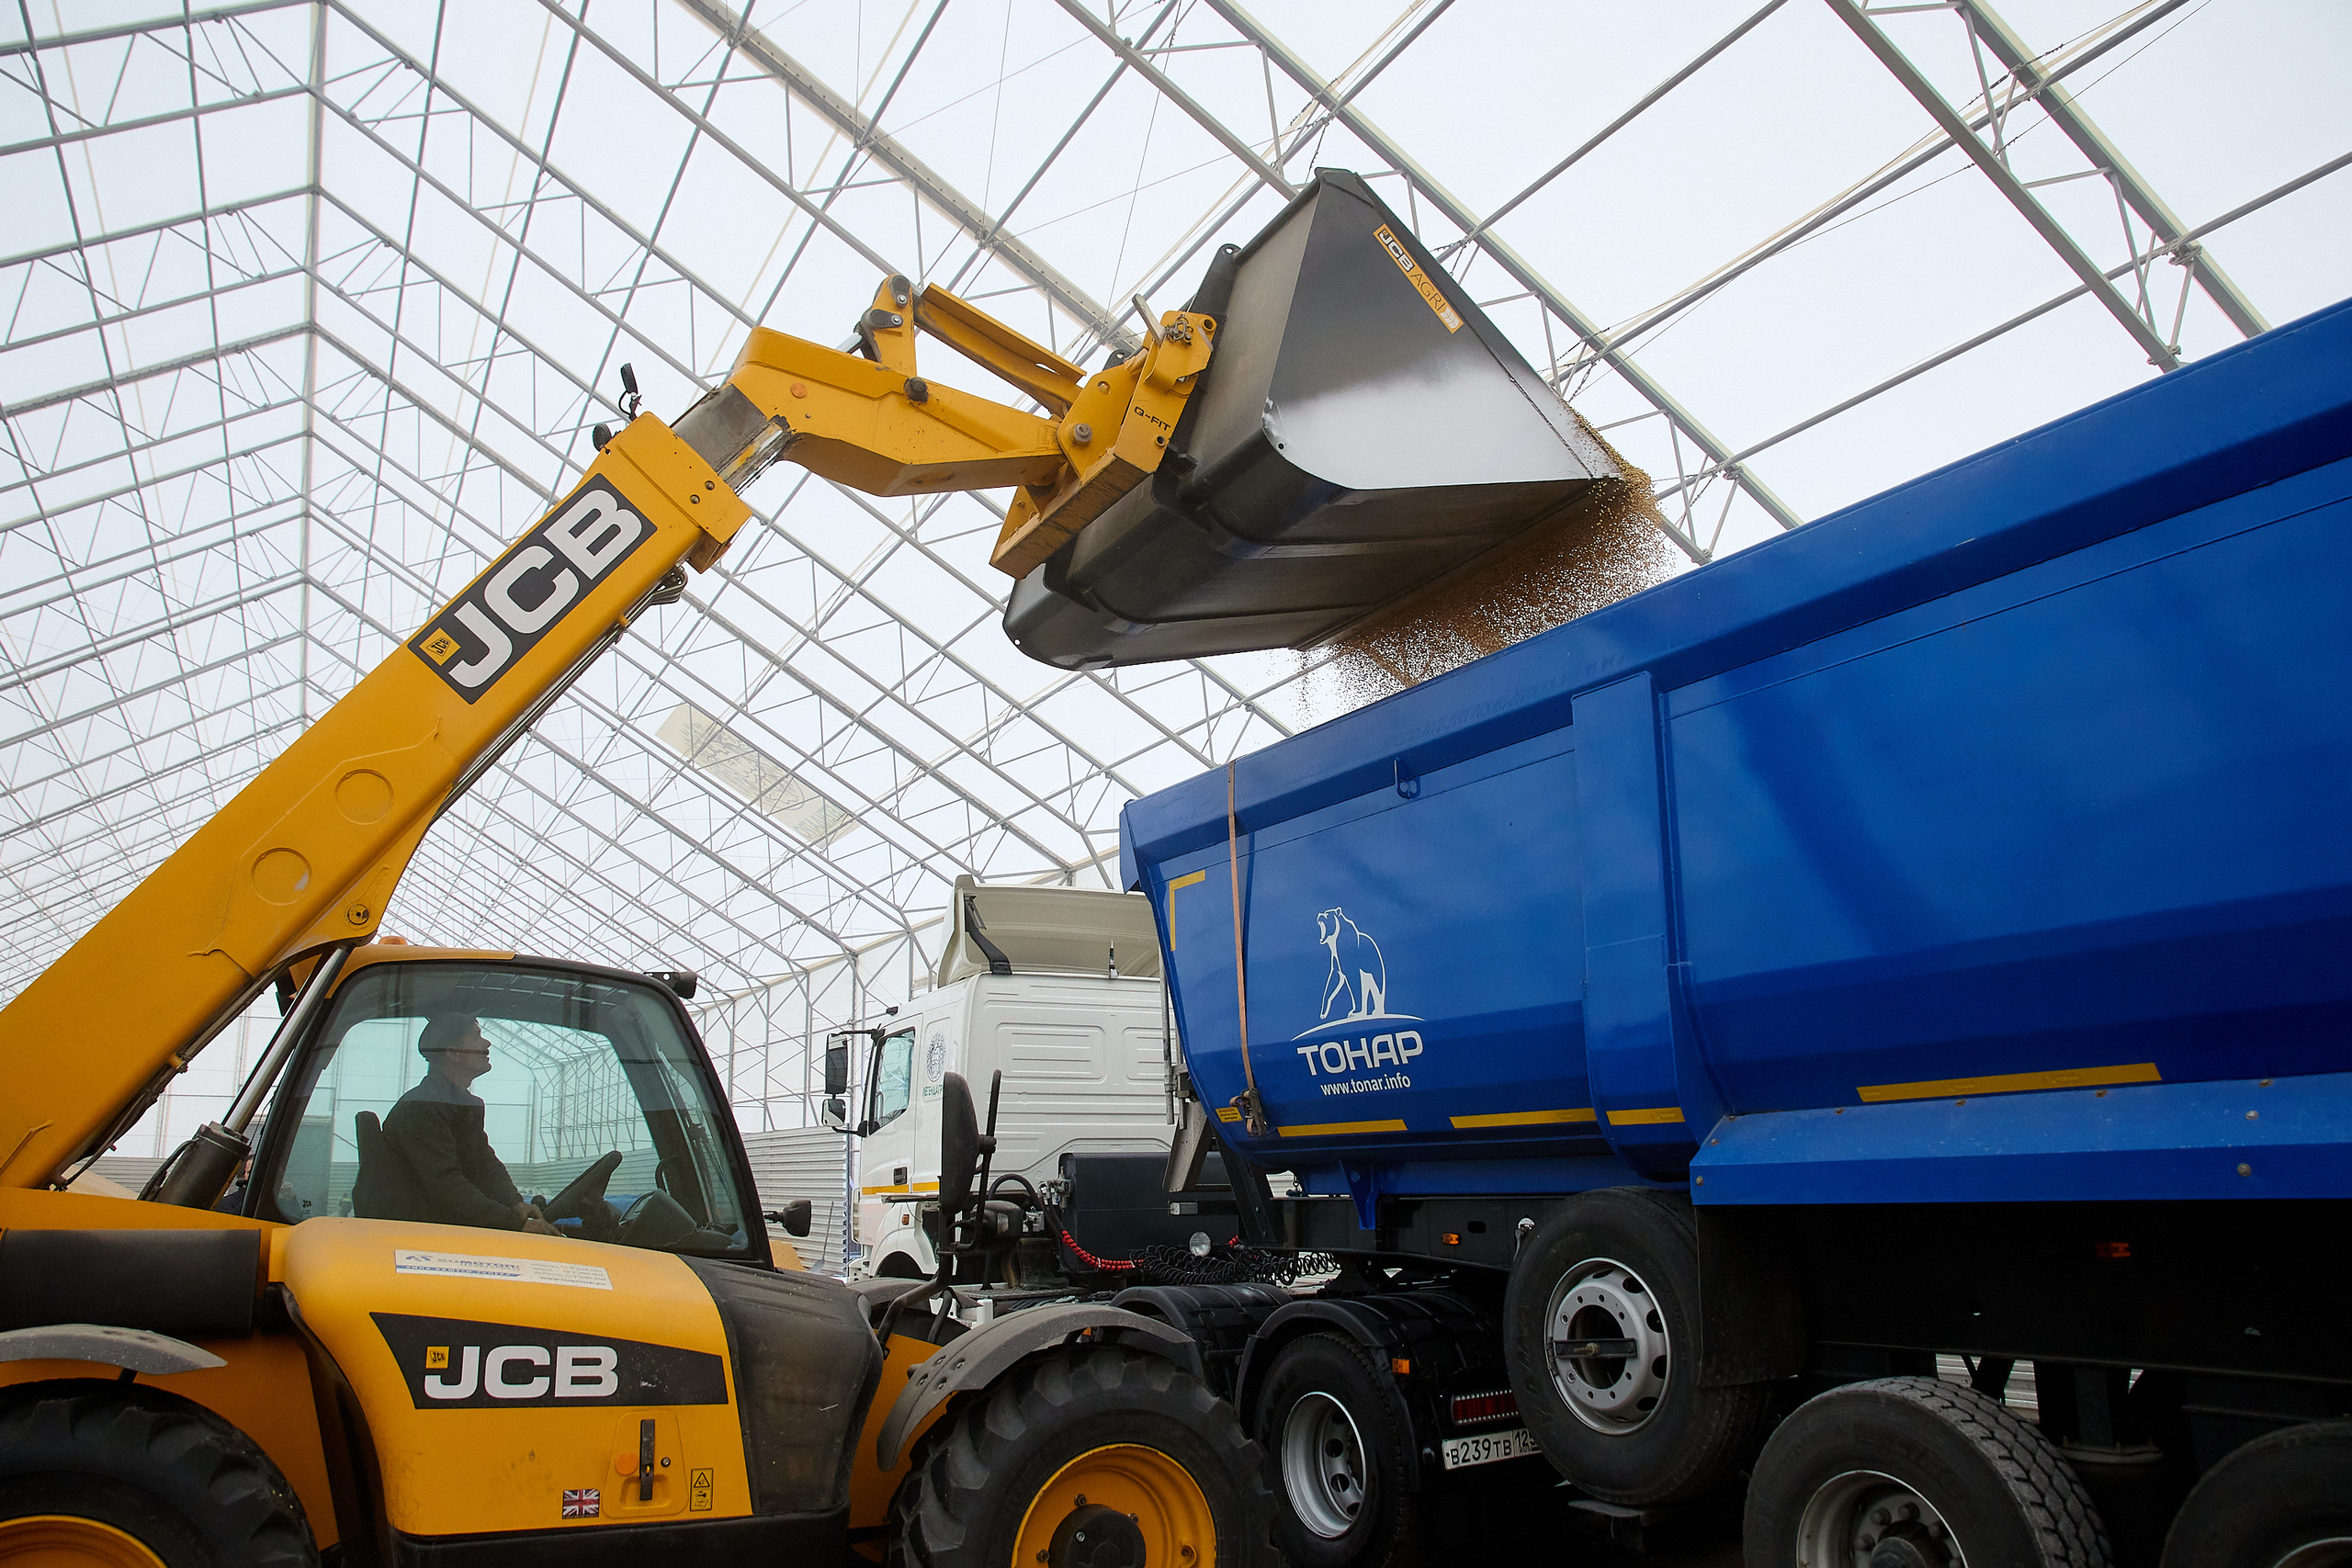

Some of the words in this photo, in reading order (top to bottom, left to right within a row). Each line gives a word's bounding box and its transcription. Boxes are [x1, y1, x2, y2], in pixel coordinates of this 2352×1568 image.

[1377, 230, 1415, 273] JCB
[1410, 273, 1446, 311] AGRI
[1134, 406, 1171, 431] Q-FIT
[448, 489, 642, 688] JCB
[430, 638, 449, 654] JCB
[1297, 1031, 1423, 1076] ТОНАР
[1320, 1072, 1411, 1096] www.tonar.info
[424, 1345, 619, 1400] JCB
[1450, 1438, 1511, 1465] В239ТВ
